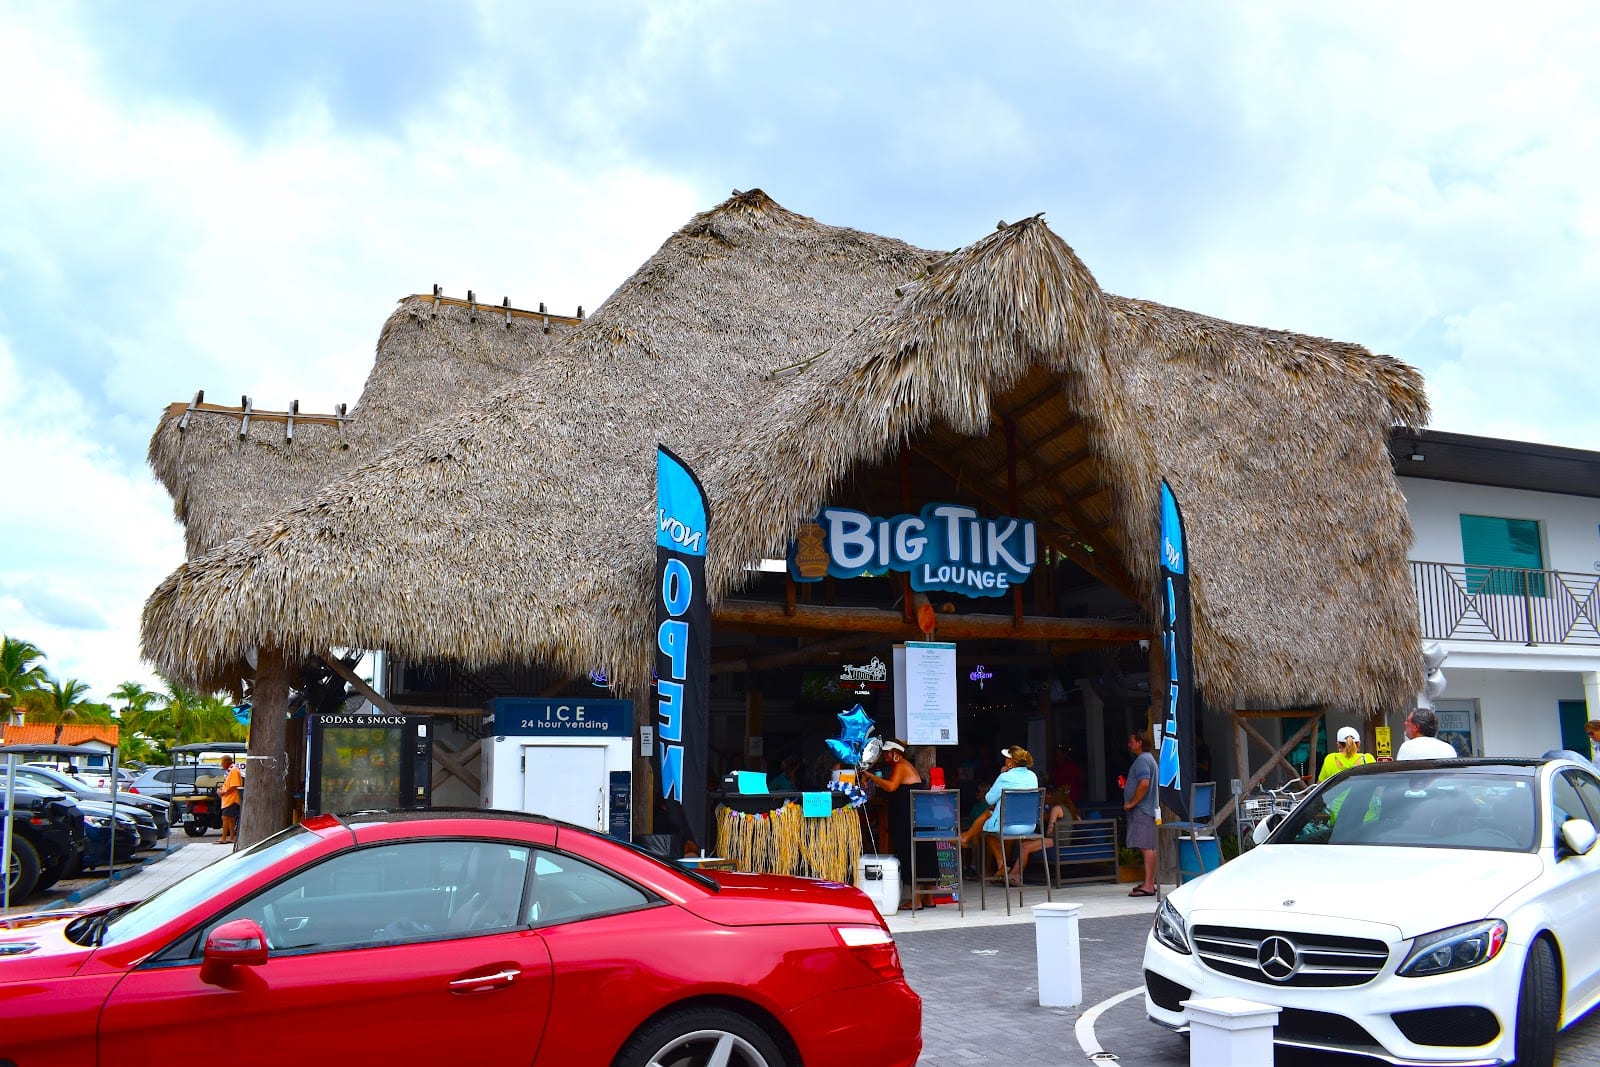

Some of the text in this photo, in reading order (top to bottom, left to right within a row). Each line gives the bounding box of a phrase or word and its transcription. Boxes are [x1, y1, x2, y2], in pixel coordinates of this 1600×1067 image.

[825, 506, 1036, 574] BIG TIKI
[924, 563, 1010, 590] LOUNGE
[320, 715, 407, 725] SODAS & SNACKS
[546, 706, 585, 721] ICE
[521, 719, 609, 731] 24 hour vending
